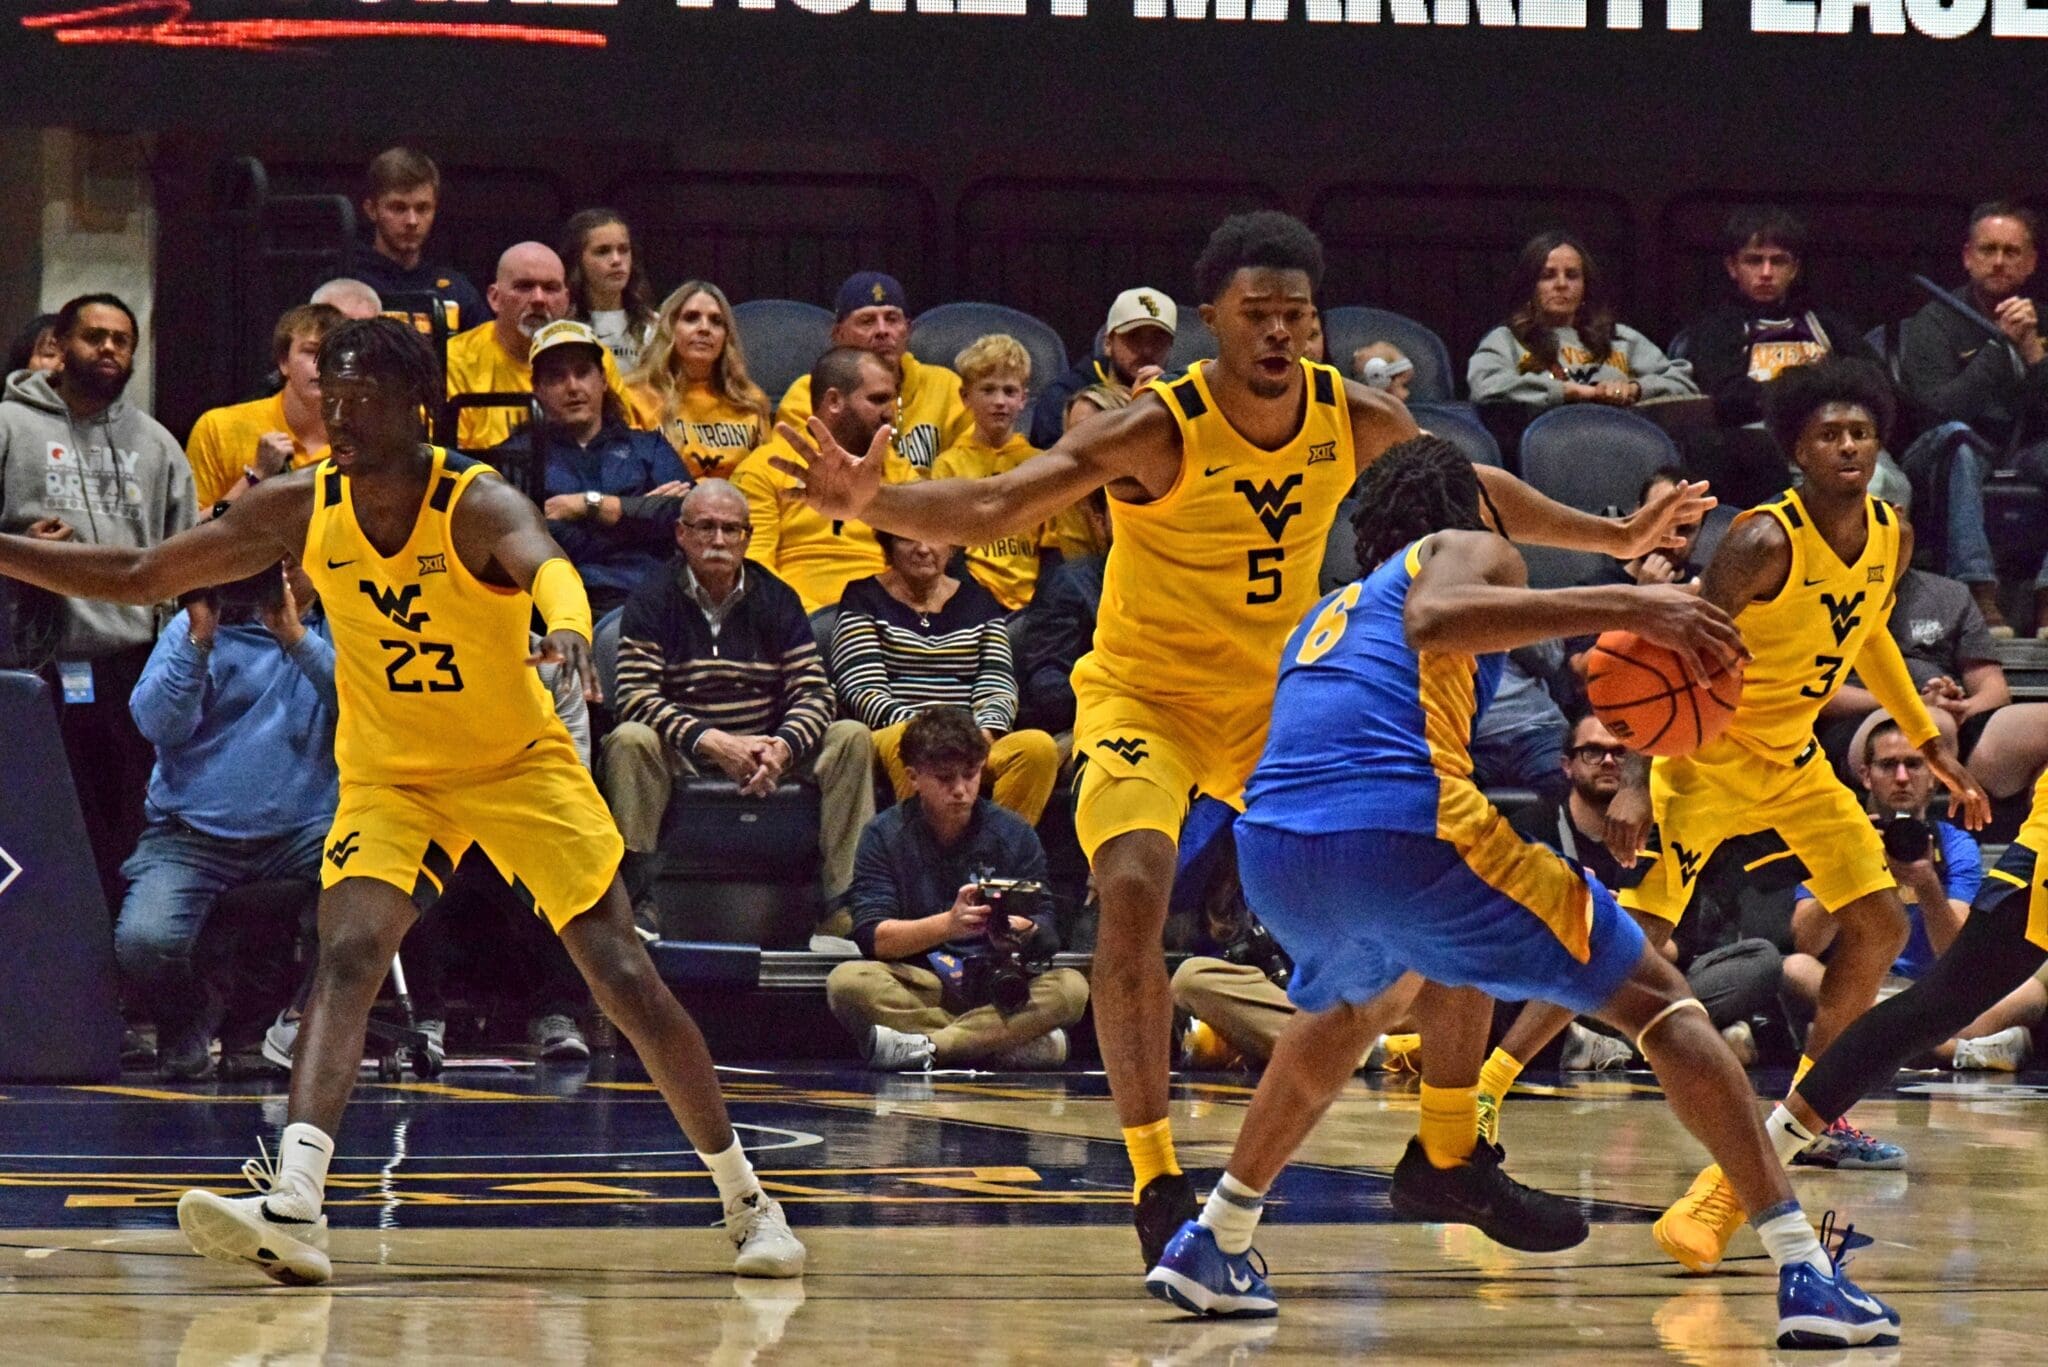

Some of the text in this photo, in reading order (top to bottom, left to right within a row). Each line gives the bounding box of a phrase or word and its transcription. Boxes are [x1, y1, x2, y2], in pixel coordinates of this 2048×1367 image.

[1246, 547, 1285, 606] 5
[1295, 582, 1363, 665] 6
[379, 638, 465, 693] 23
[1800, 654, 1845, 699] 3
